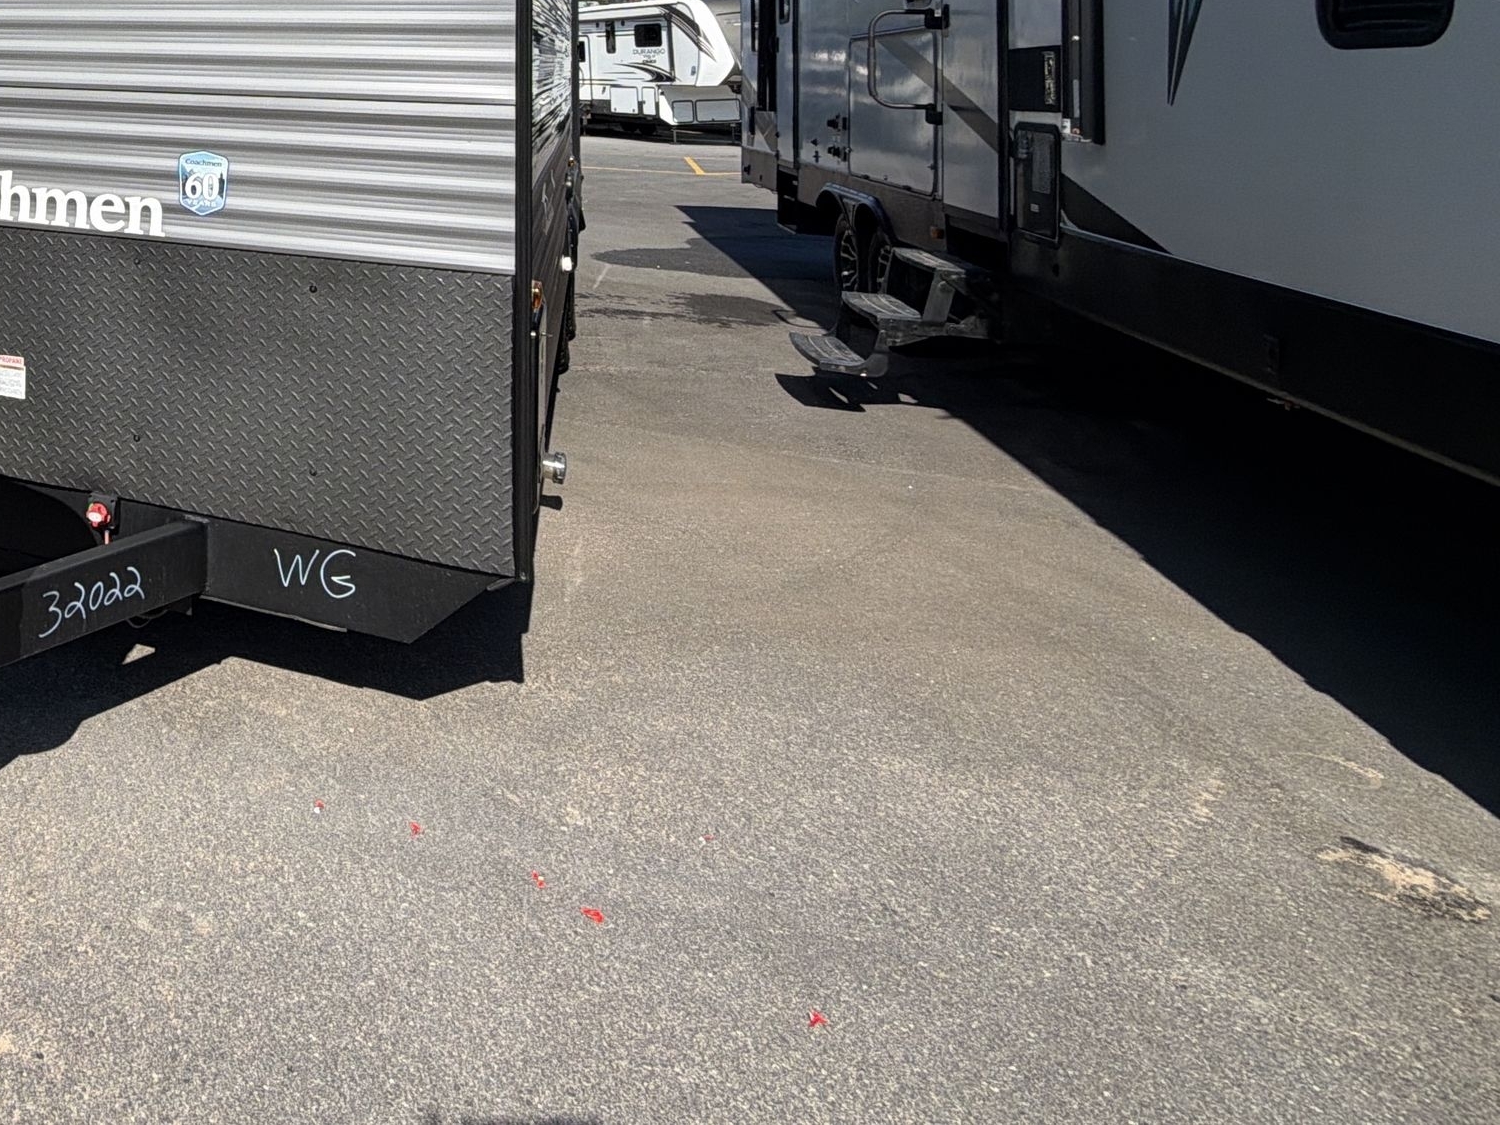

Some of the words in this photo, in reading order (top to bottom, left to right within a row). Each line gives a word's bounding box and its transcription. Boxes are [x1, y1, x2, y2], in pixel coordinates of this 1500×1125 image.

[185, 158, 223, 168] Coachmen
[184, 172, 220, 201] 60
[273, 548, 356, 599] WG
[38, 566, 145, 638] 32022
